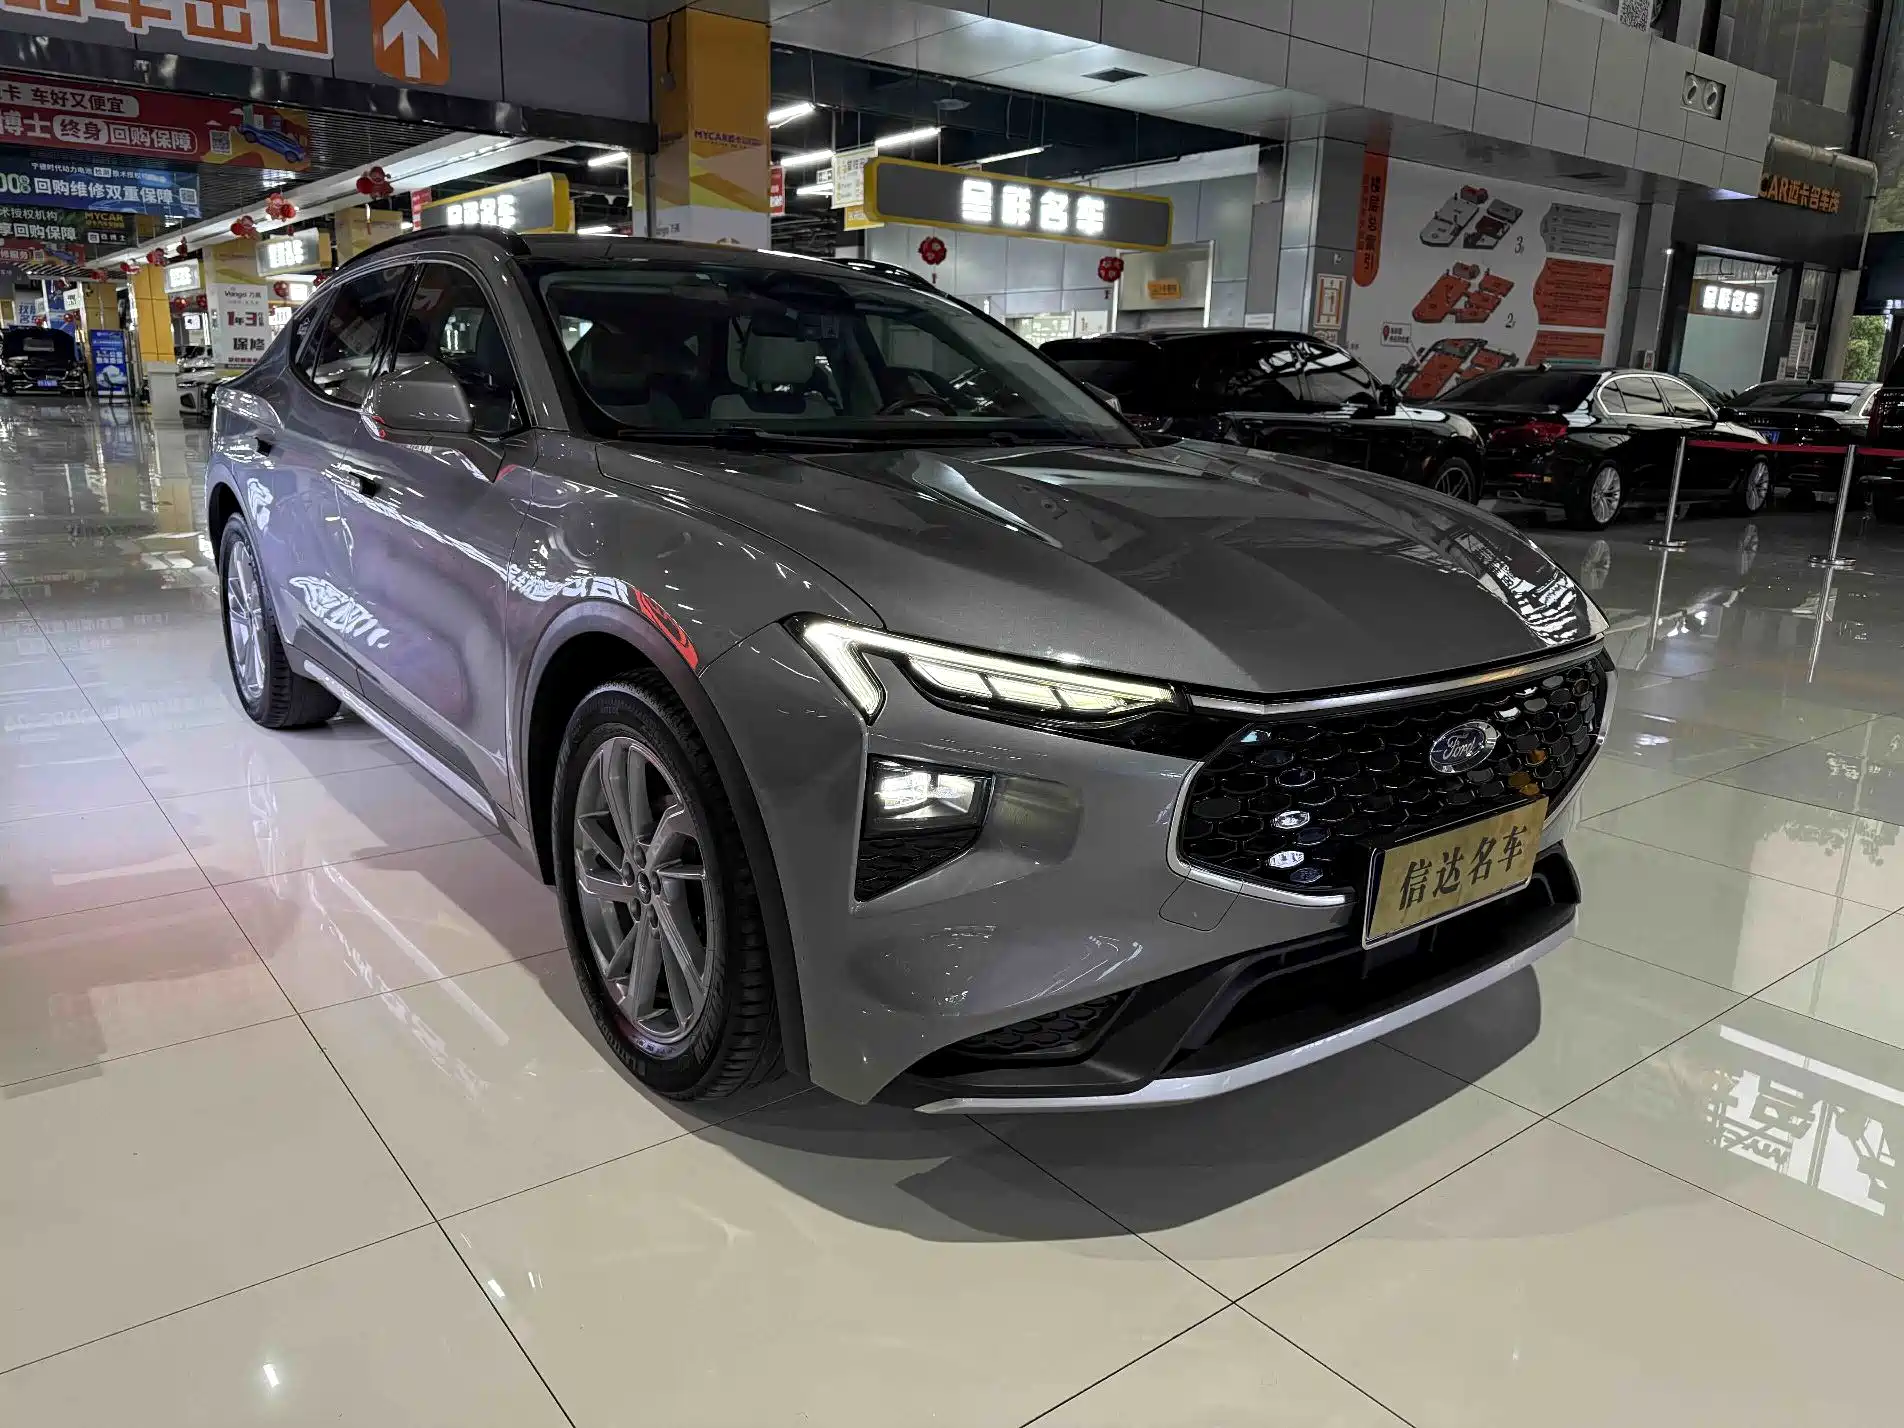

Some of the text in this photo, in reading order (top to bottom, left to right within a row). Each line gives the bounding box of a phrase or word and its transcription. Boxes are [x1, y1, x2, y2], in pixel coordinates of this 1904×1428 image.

[31, 87, 125, 114] 车好又便宜
[60, 118, 102, 141] 终身
[109, 124, 193, 151] 回购保障
[34, 177, 174, 204] 回购维修双重保障
[1442, 734, 1478, 760] Ford
[1398, 825, 1528, 912] 信达名车
